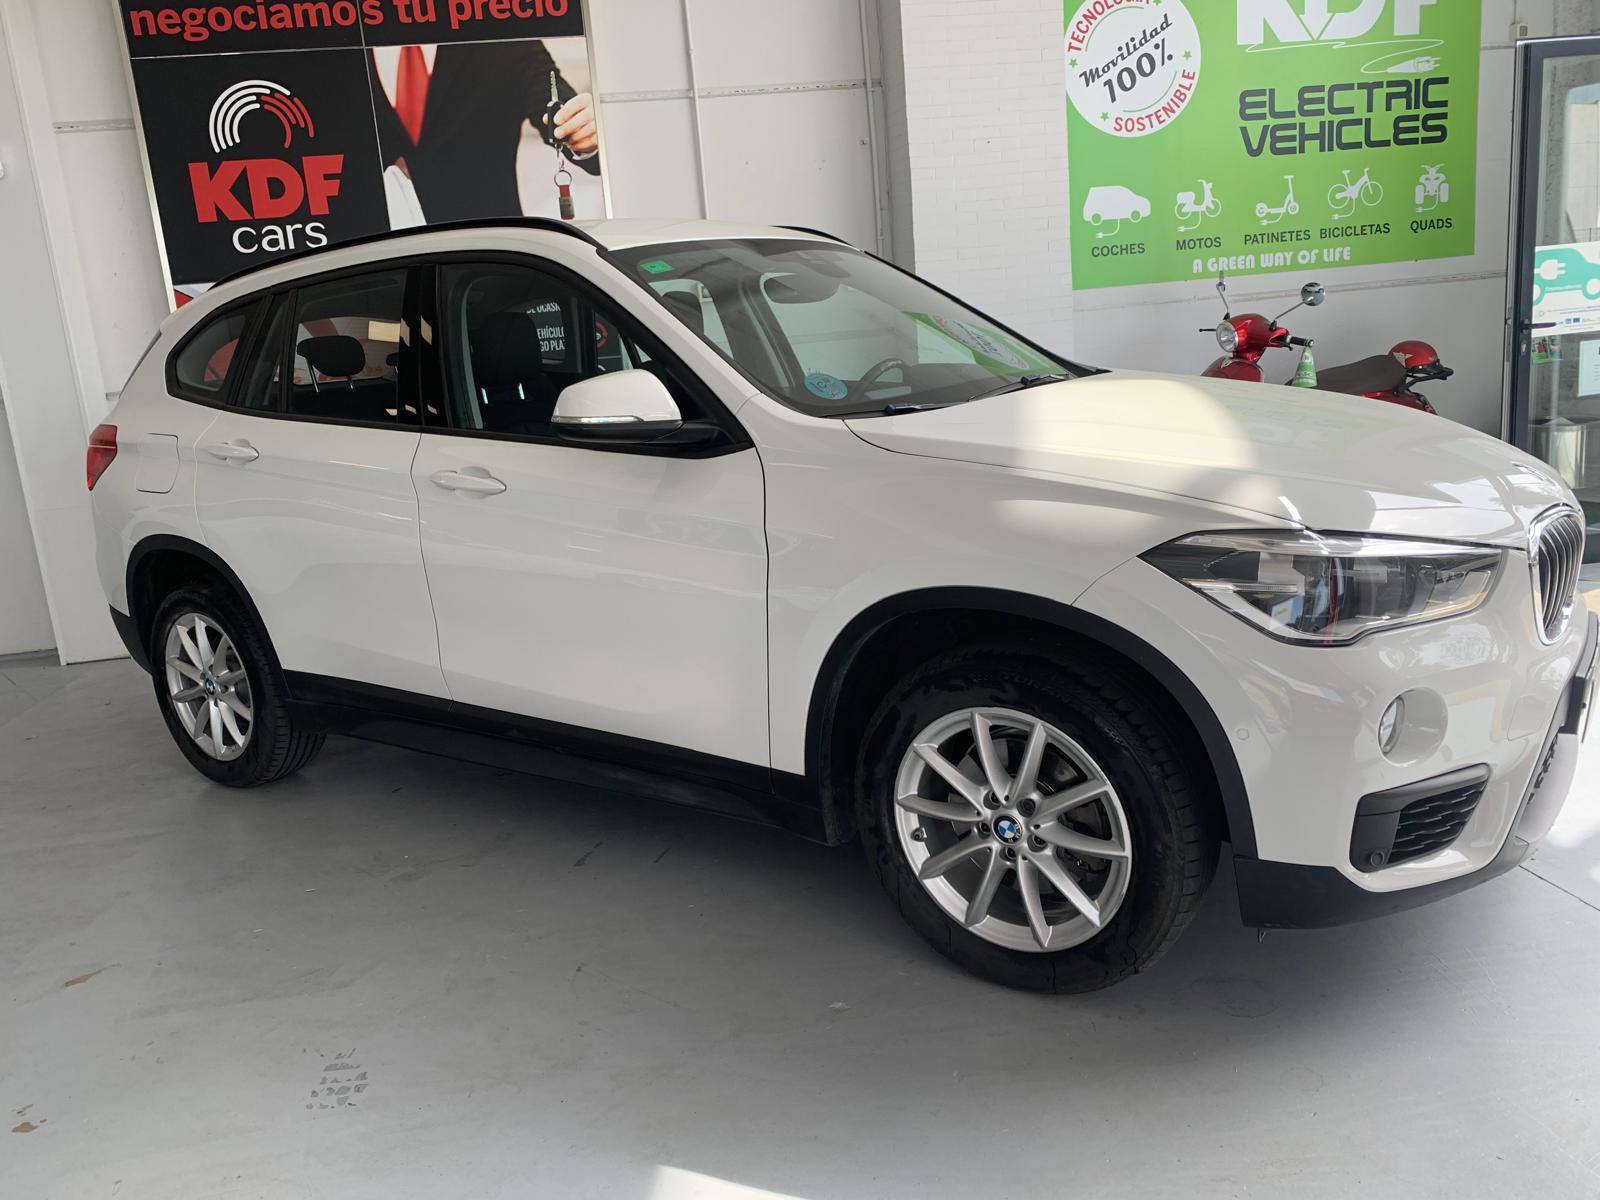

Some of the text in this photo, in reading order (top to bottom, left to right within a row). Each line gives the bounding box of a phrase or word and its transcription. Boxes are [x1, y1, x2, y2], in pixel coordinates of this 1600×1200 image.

[130, 0, 568, 42] negociamos tu precio
[1068, 0, 1150, 53] TECNOL
[1079, 13, 1172, 87] Movilidad
[1103, 38, 1173, 103] 100%
[1113, 69, 1196, 133] SOSTENIBLE
[1239, 76, 1449, 121] ELECTRIC
[1239, 112, 1448, 157] VEHICLES
[188, 154, 344, 223] KDF
[232, 222, 328, 253] cars
[1176, 236, 1222, 251] MOTOS
[1244, 229, 1311, 245] PATINETES
[1319, 223, 1391, 239] BICICLETAS
[1410, 218, 1453, 234] QUADS
[1091, 243, 1146, 258] COCHES
[1192, 246, 1351, 273] A GREEN WAY OF LIFE
